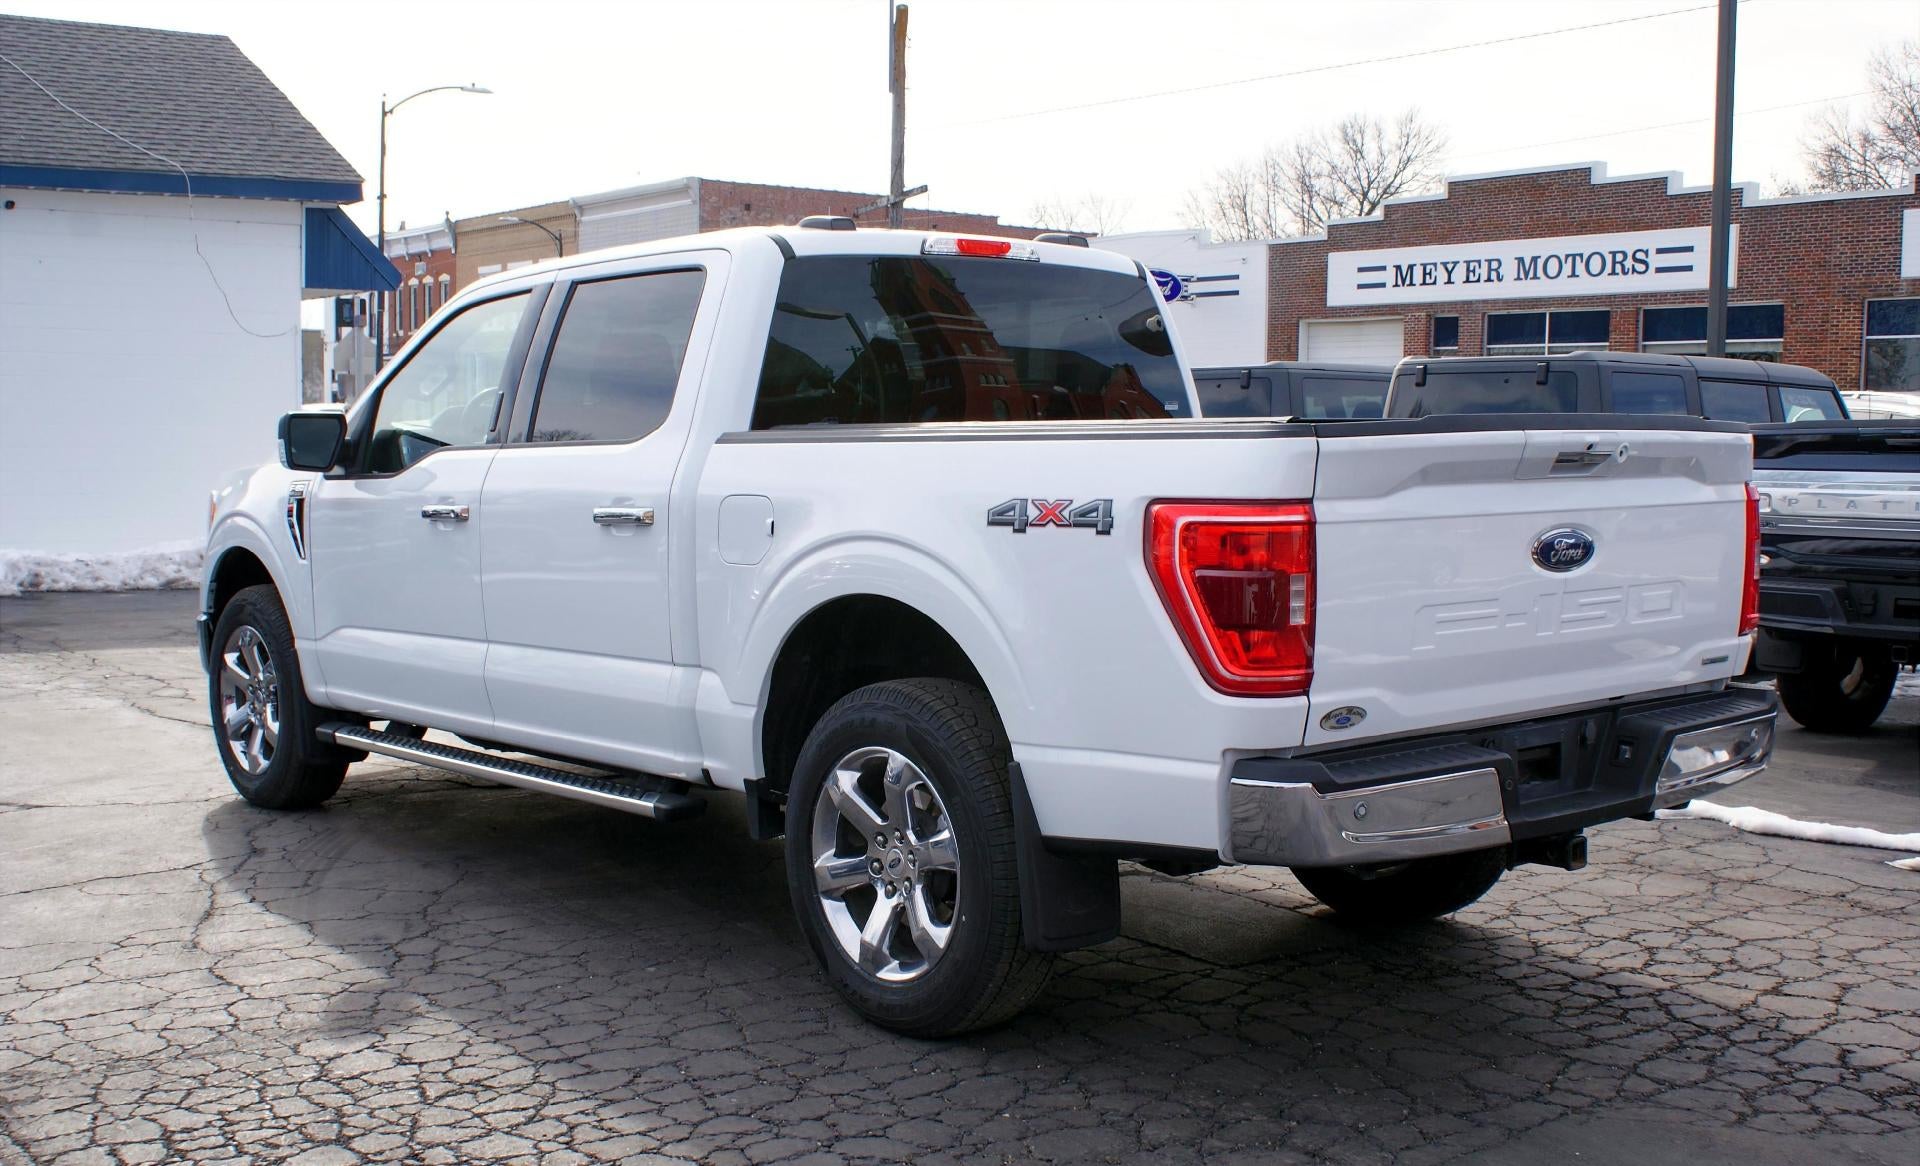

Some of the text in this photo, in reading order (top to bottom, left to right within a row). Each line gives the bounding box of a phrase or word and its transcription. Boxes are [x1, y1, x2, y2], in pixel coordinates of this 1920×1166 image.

[1392, 248, 1650, 288] MEYER MOTORS
[1550, 538, 1585, 563] Ford
[1411, 580, 1686, 651] F-150
